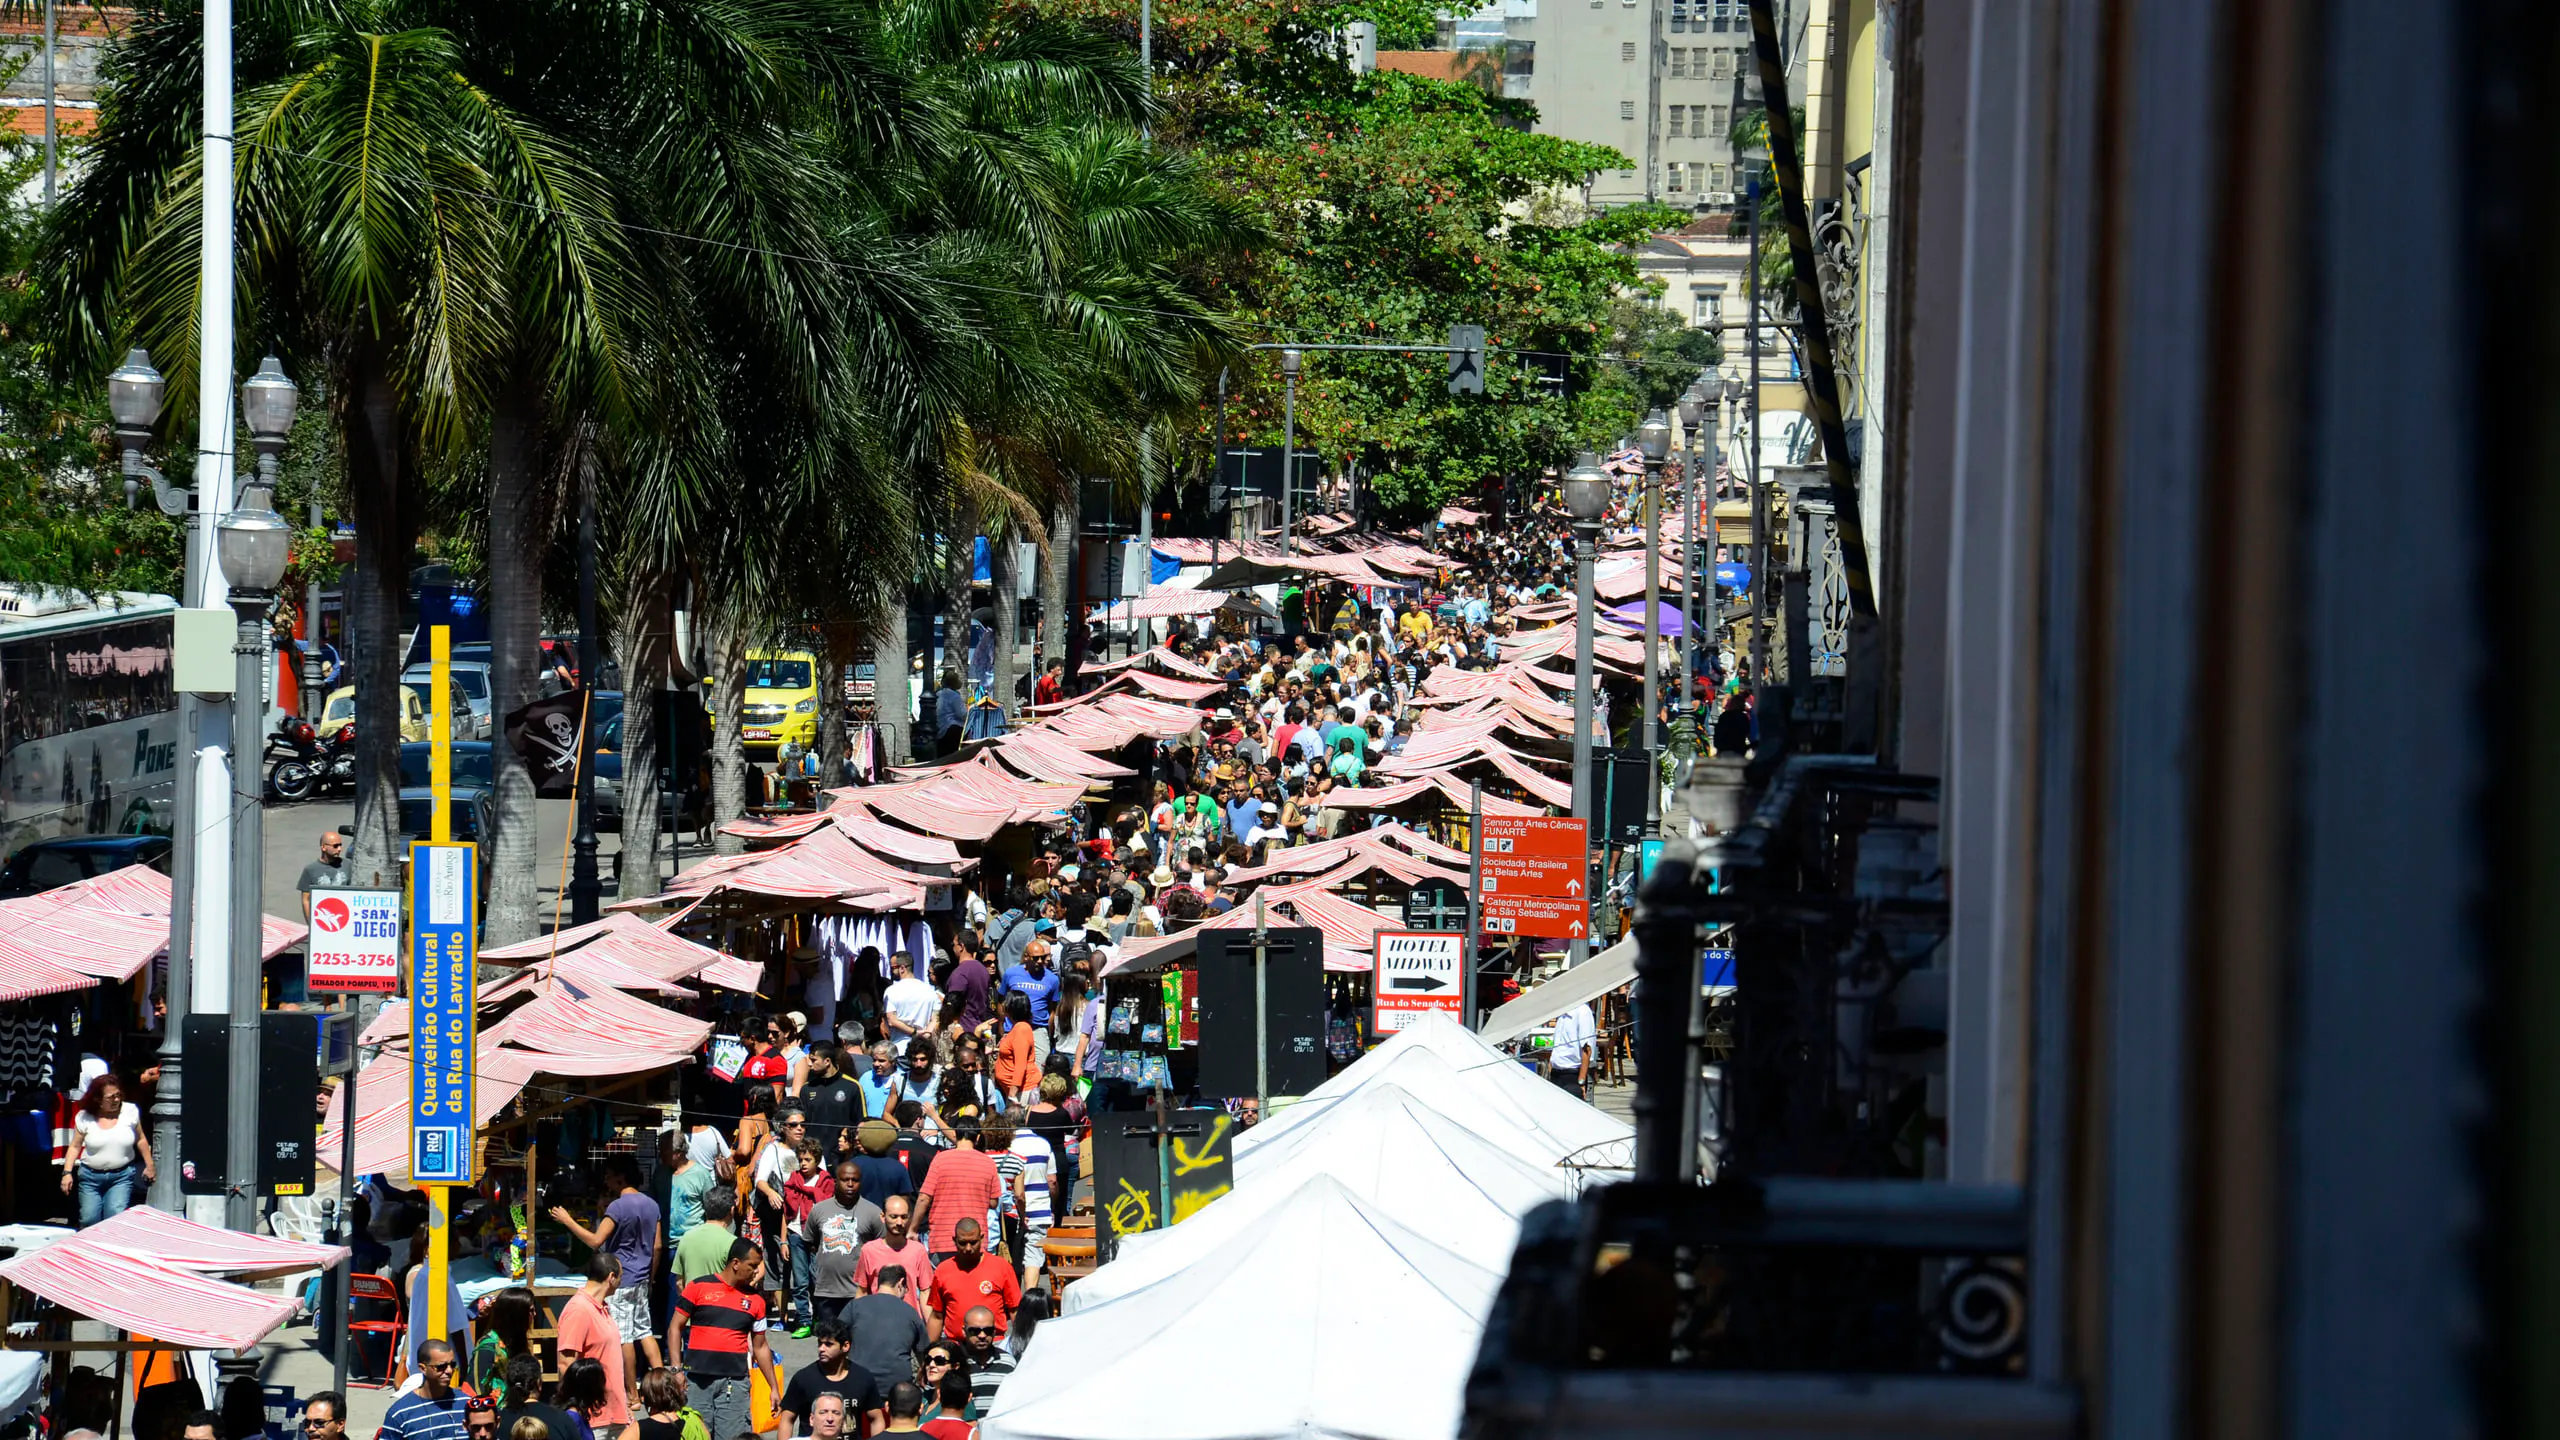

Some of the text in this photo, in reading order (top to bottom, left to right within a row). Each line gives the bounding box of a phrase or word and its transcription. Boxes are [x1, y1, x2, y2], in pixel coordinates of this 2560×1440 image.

[1483, 818, 1583, 830] Centro de Artes Cênicas
[1484, 827, 1527, 836] FUNARTE
[1483, 857, 1568, 870] Sociedade Brasileira
[1495, 868, 1518, 877] Belas
[1520, 869, 1543, 878] Artes
[353, 895, 397, 907] HOTEL
[1487, 898, 1580, 911] Catedral Metropolitana
[361, 909, 389, 920] SAN
[1486, 906, 1560, 919] de São Sebastião
[353, 921, 396, 937] DIEGO
[1389, 940, 1449, 952] HOTEL
[313, 952, 395, 966] 2253-3756
[1710, 951, 1721, 959] do
[311, 979, 345, 987] SENADOR
[347, 980, 380, 988] POMPEU,
[1397, 999, 1409, 1007] do
[1411, 999, 1447, 1008] Senado,
[420, 933, 439, 1116] Quarteirão Cultural
[446, 931, 464, 1113] da Rua do Lavradio
[427, 1133, 439, 1152] RIO
